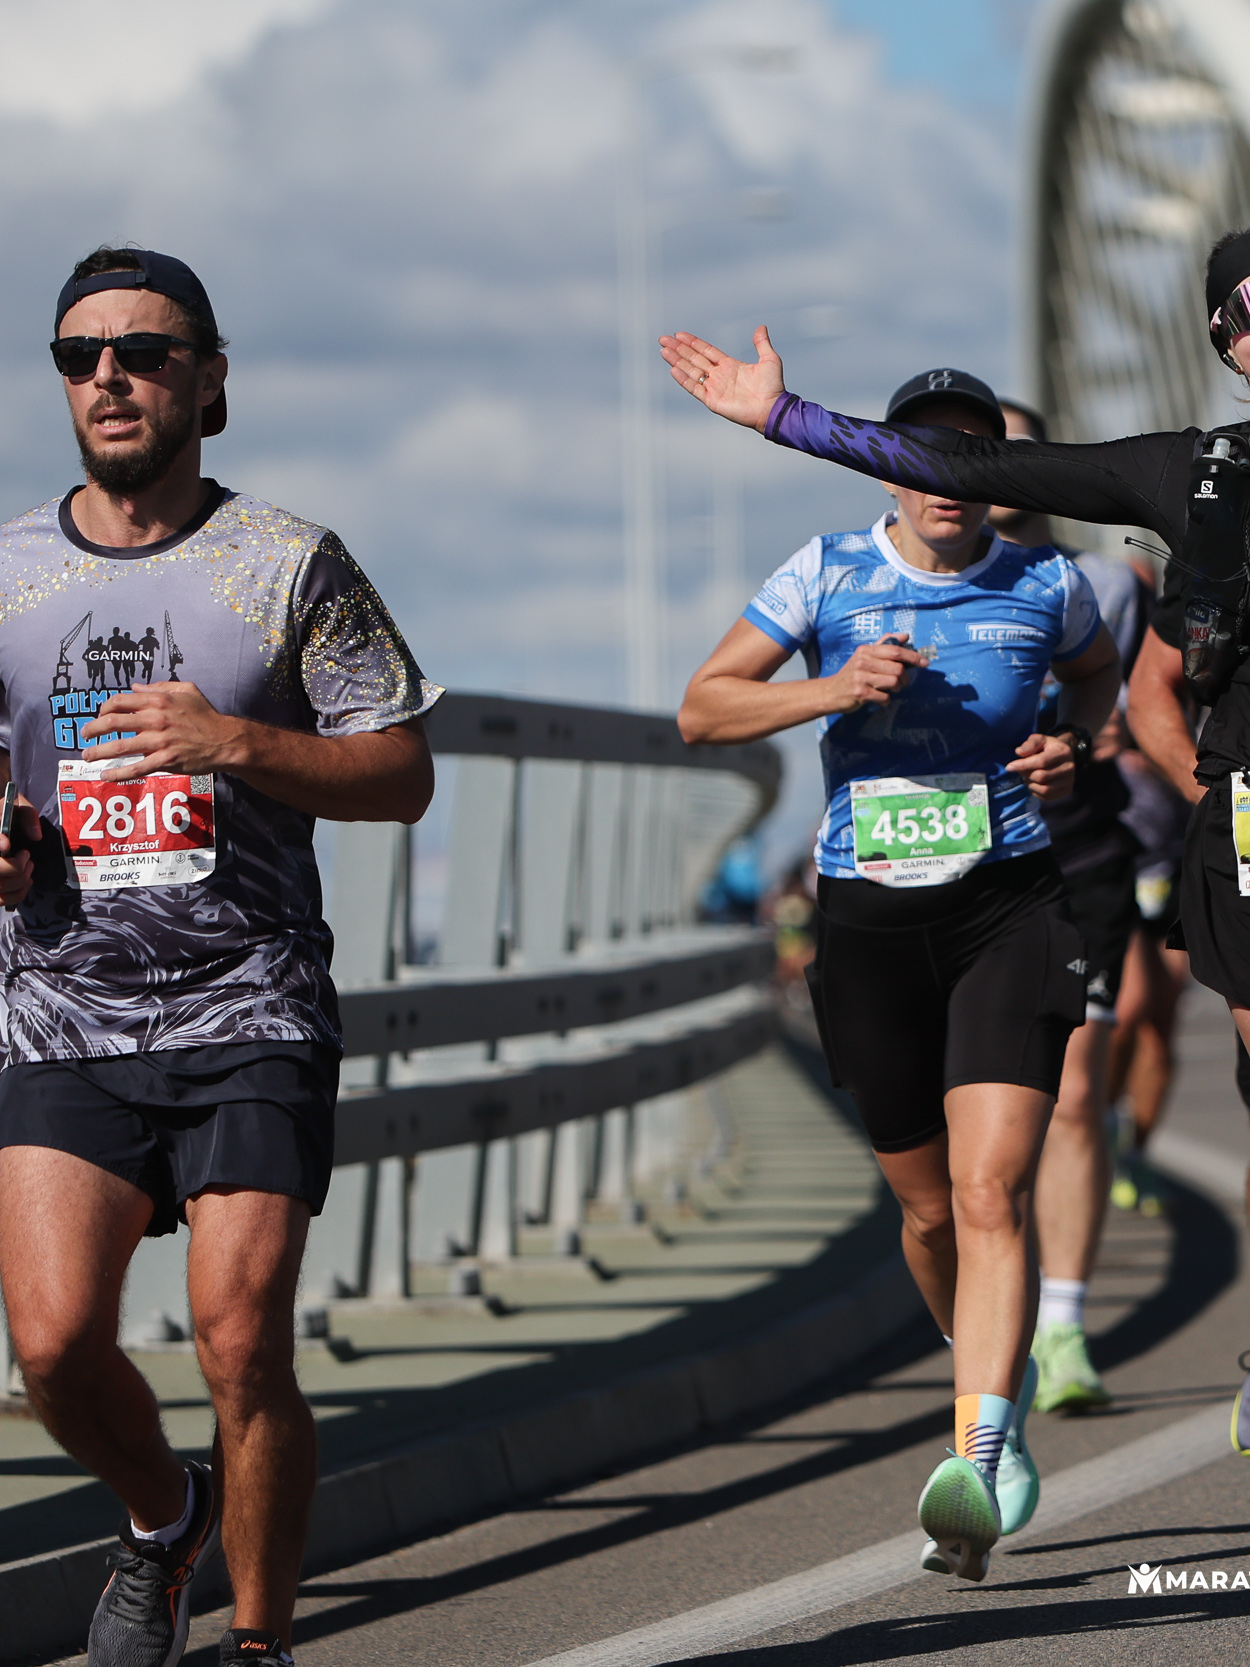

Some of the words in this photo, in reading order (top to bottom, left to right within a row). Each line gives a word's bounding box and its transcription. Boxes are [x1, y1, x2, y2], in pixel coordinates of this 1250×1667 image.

[89, 651, 150, 661] GARMIN
[78, 790, 191, 840] 2816
[870, 804, 969, 846] 4538
[110, 840, 160, 853] Krzysztof
[909, 847, 934, 856] Anna
[110, 855, 160, 867] GARMIN
[902, 859, 944, 869] GARMIN
[99, 871, 141, 882] BROOKS
[894, 872, 928, 881] BROOKS
